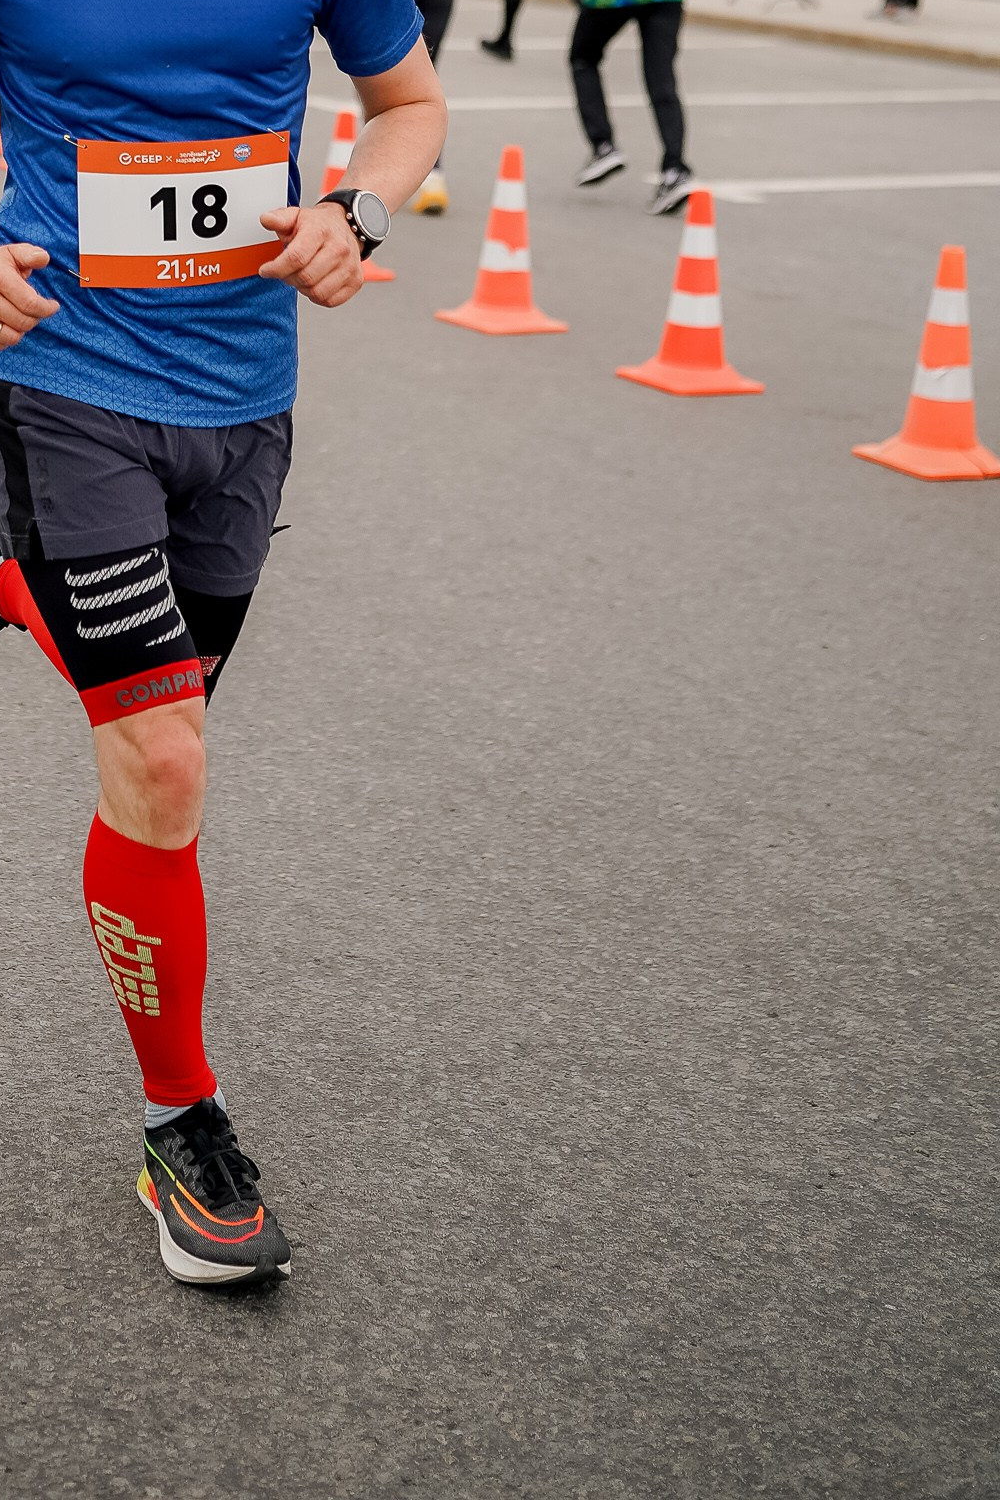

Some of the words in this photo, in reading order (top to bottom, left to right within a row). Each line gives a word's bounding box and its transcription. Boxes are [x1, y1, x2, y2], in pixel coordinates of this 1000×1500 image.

[134, 155, 162, 164] СБЕР
[176, 157, 205, 165] марафон
[150, 184, 228, 241] 18
